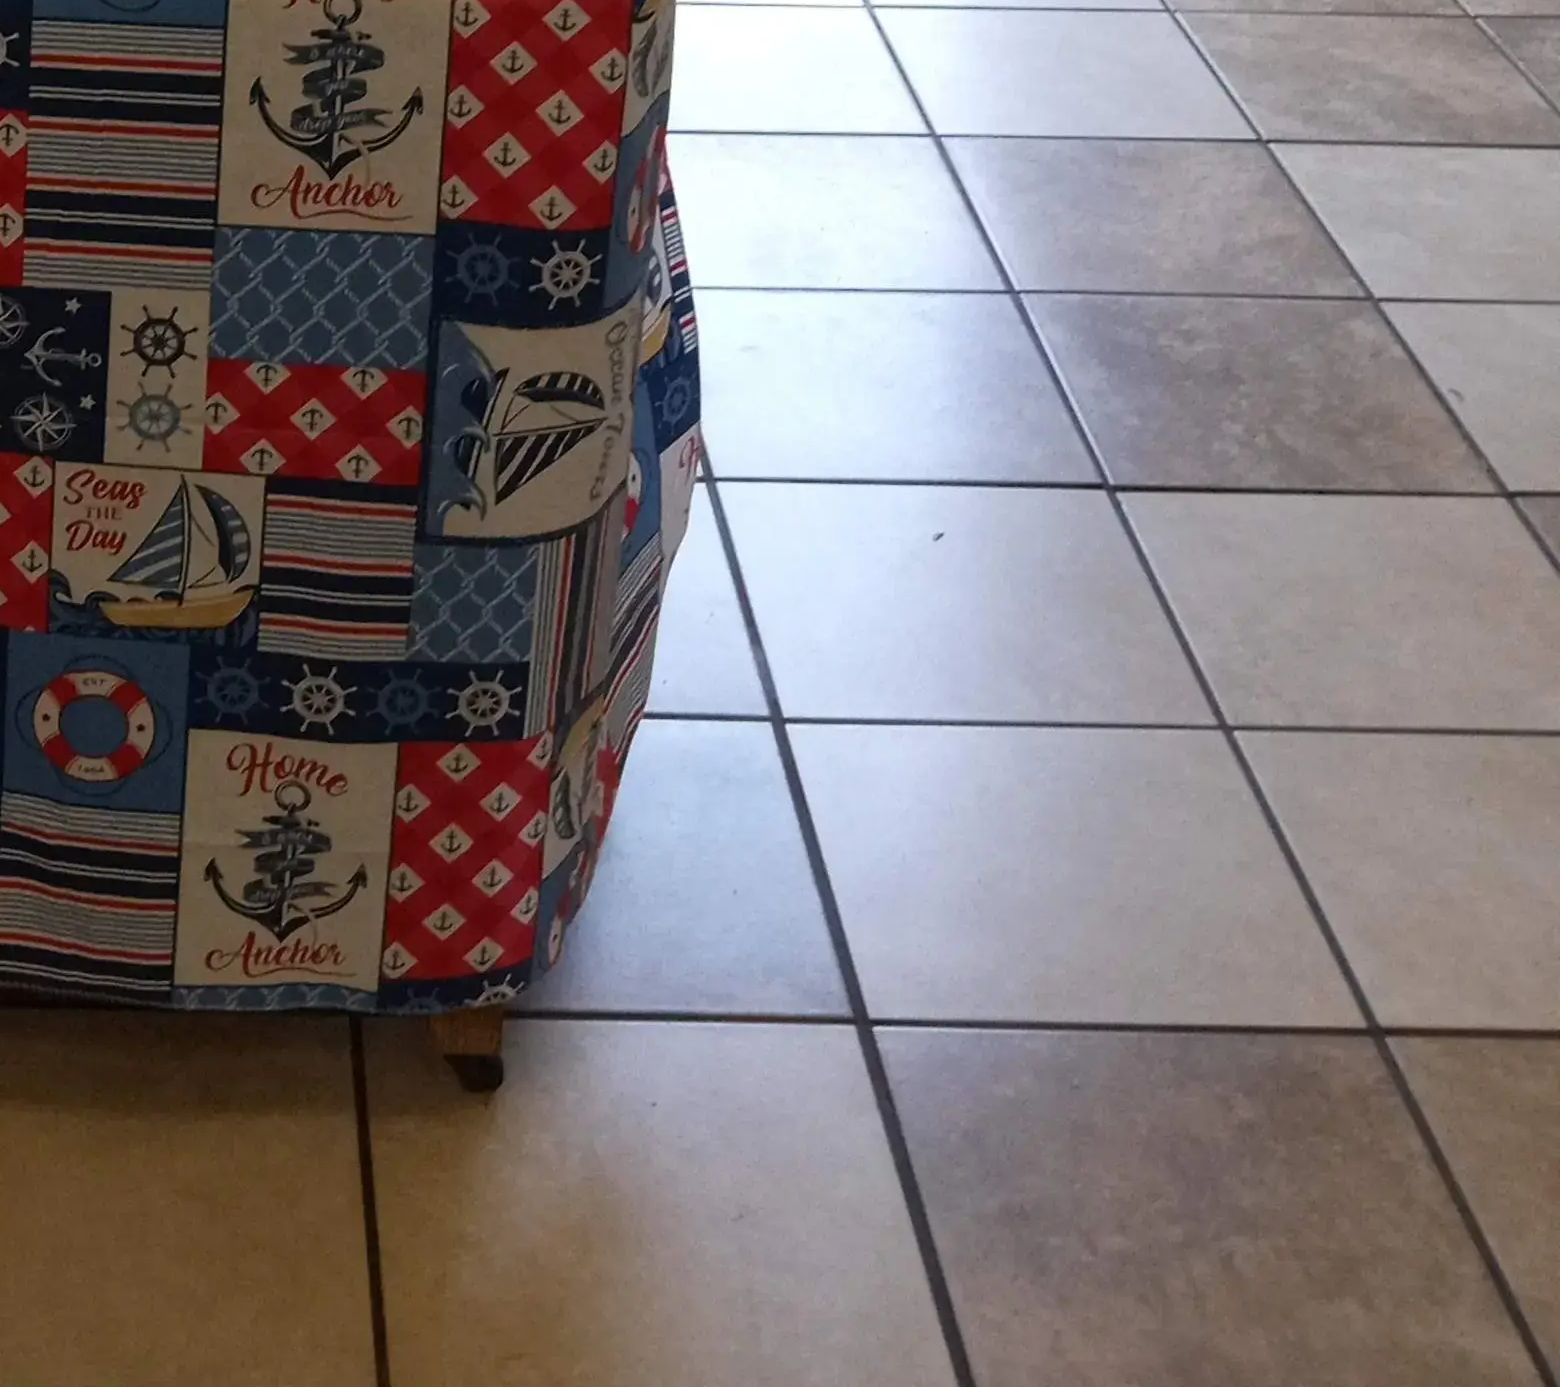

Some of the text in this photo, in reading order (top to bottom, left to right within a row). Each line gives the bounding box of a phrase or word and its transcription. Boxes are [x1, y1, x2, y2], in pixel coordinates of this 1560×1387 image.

[251, 164, 408, 220] Anchor
[63, 469, 148, 509] Seas
[65, 520, 127, 556] Day
[226, 742, 348, 797] Home
[205, 931, 354, 977] Anchor
